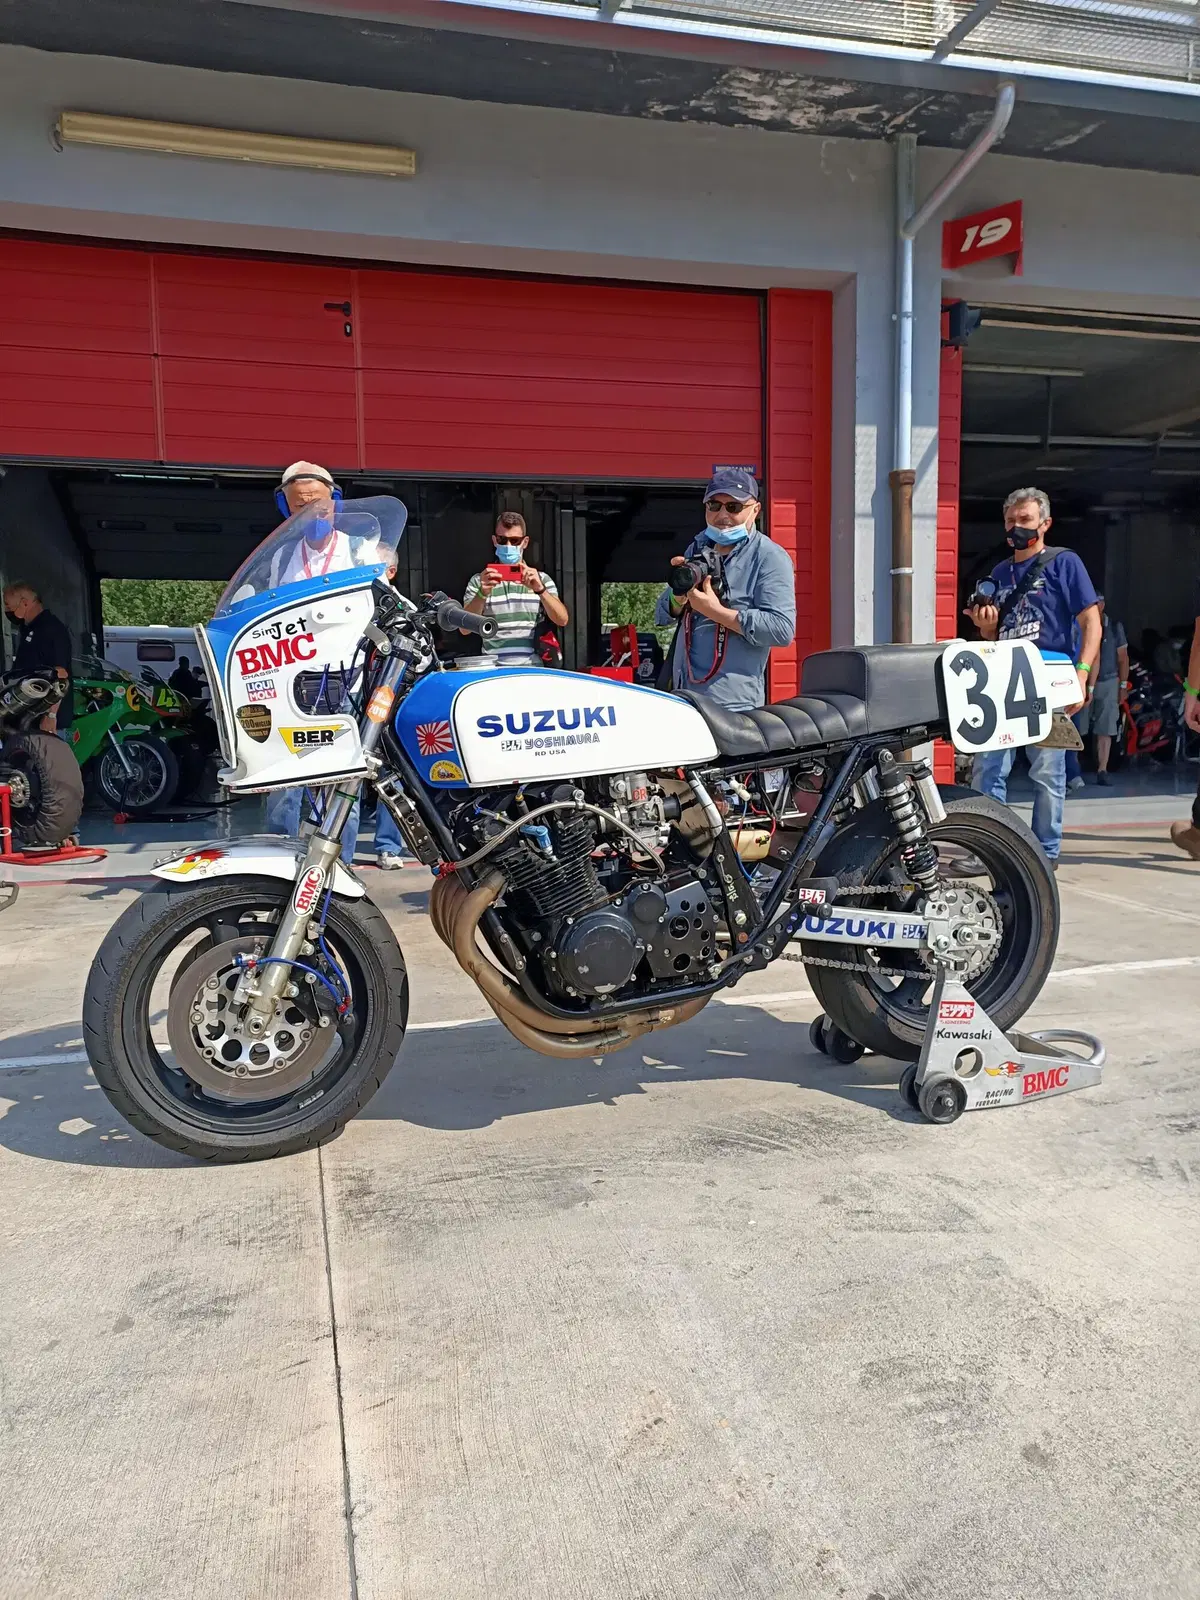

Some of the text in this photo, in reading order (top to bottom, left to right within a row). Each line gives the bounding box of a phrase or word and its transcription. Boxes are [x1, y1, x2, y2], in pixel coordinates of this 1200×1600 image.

[960, 217, 1012, 252] 19
[235, 632, 317, 676] BMC
[241, 668, 280, 681] CHASSIS
[246, 680, 275, 692] LIQUI
[249, 689, 276, 701] MOLY
[949, 645, 1048, 746] 34
[476, 705, 617, 738] SUZUKI
[293, 730, 335, 744] BER
[525, 732, 600, 750] YOSHIMURA
[296, 870, 321, 911] BMC
[790, 912, 895, 939] UZUKI
[937, 1028, 992, 1040] Kawasaki
[1023, 1066, 1069, 1095] BMC
[985, 1089, 1014, 1099] RACING
